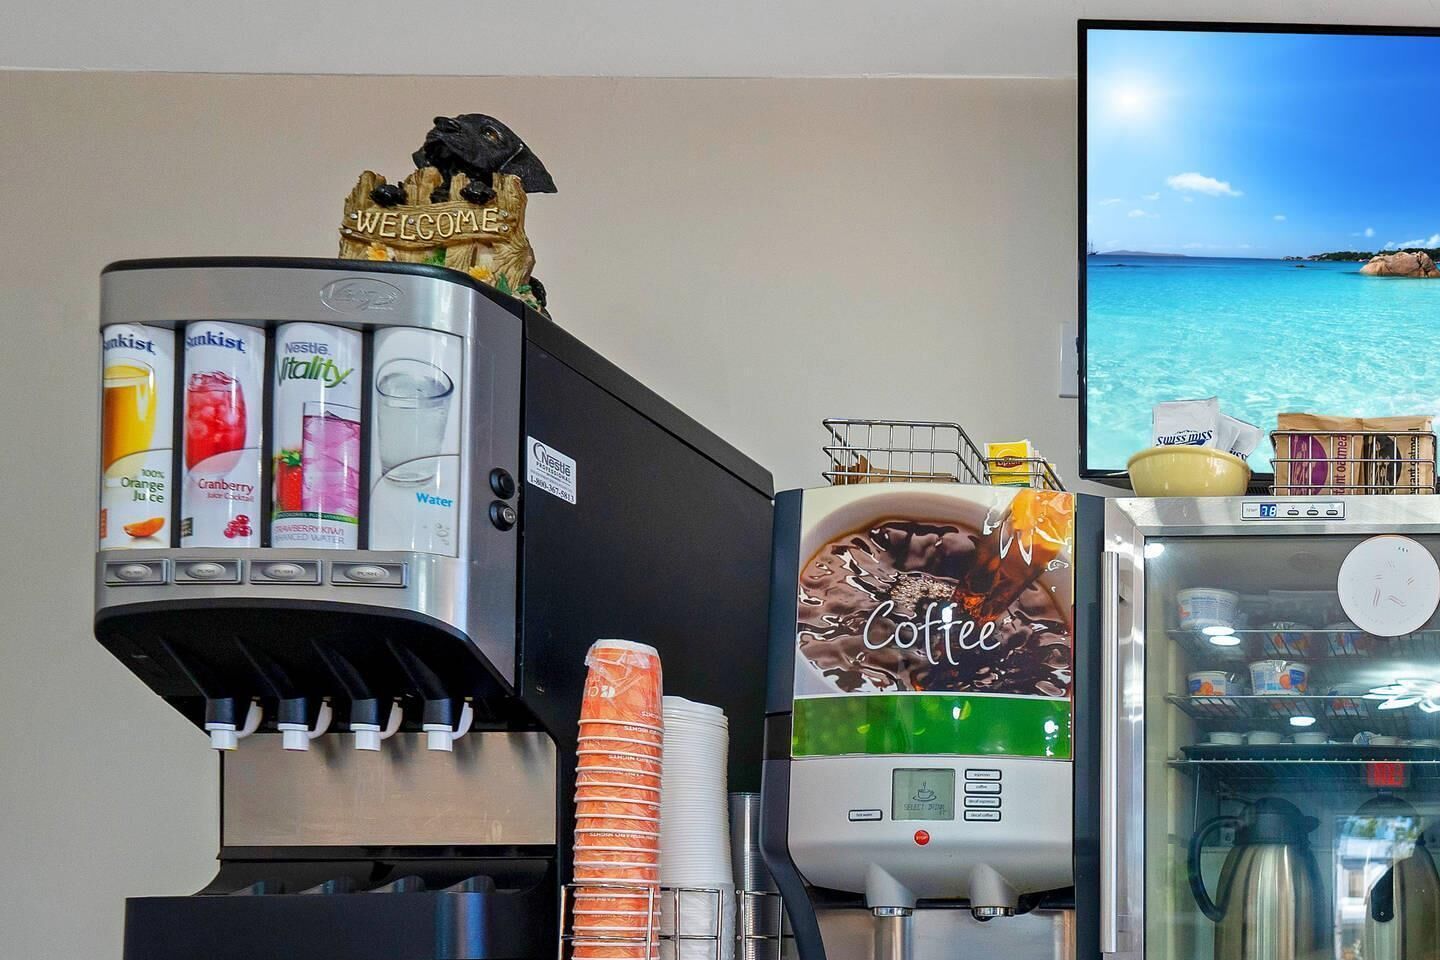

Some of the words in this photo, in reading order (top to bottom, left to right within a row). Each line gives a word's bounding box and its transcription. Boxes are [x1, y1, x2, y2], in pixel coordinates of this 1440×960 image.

[357, 207, 499, 241] WELCOME
[103, 333, 155, 354] unkist
[121, 476, 165, 493] Orange
[198, 478, 254, 496] Cranberry
[416, 492, 454, 508] Water
[863, 600, 1001, 665] Coffee
